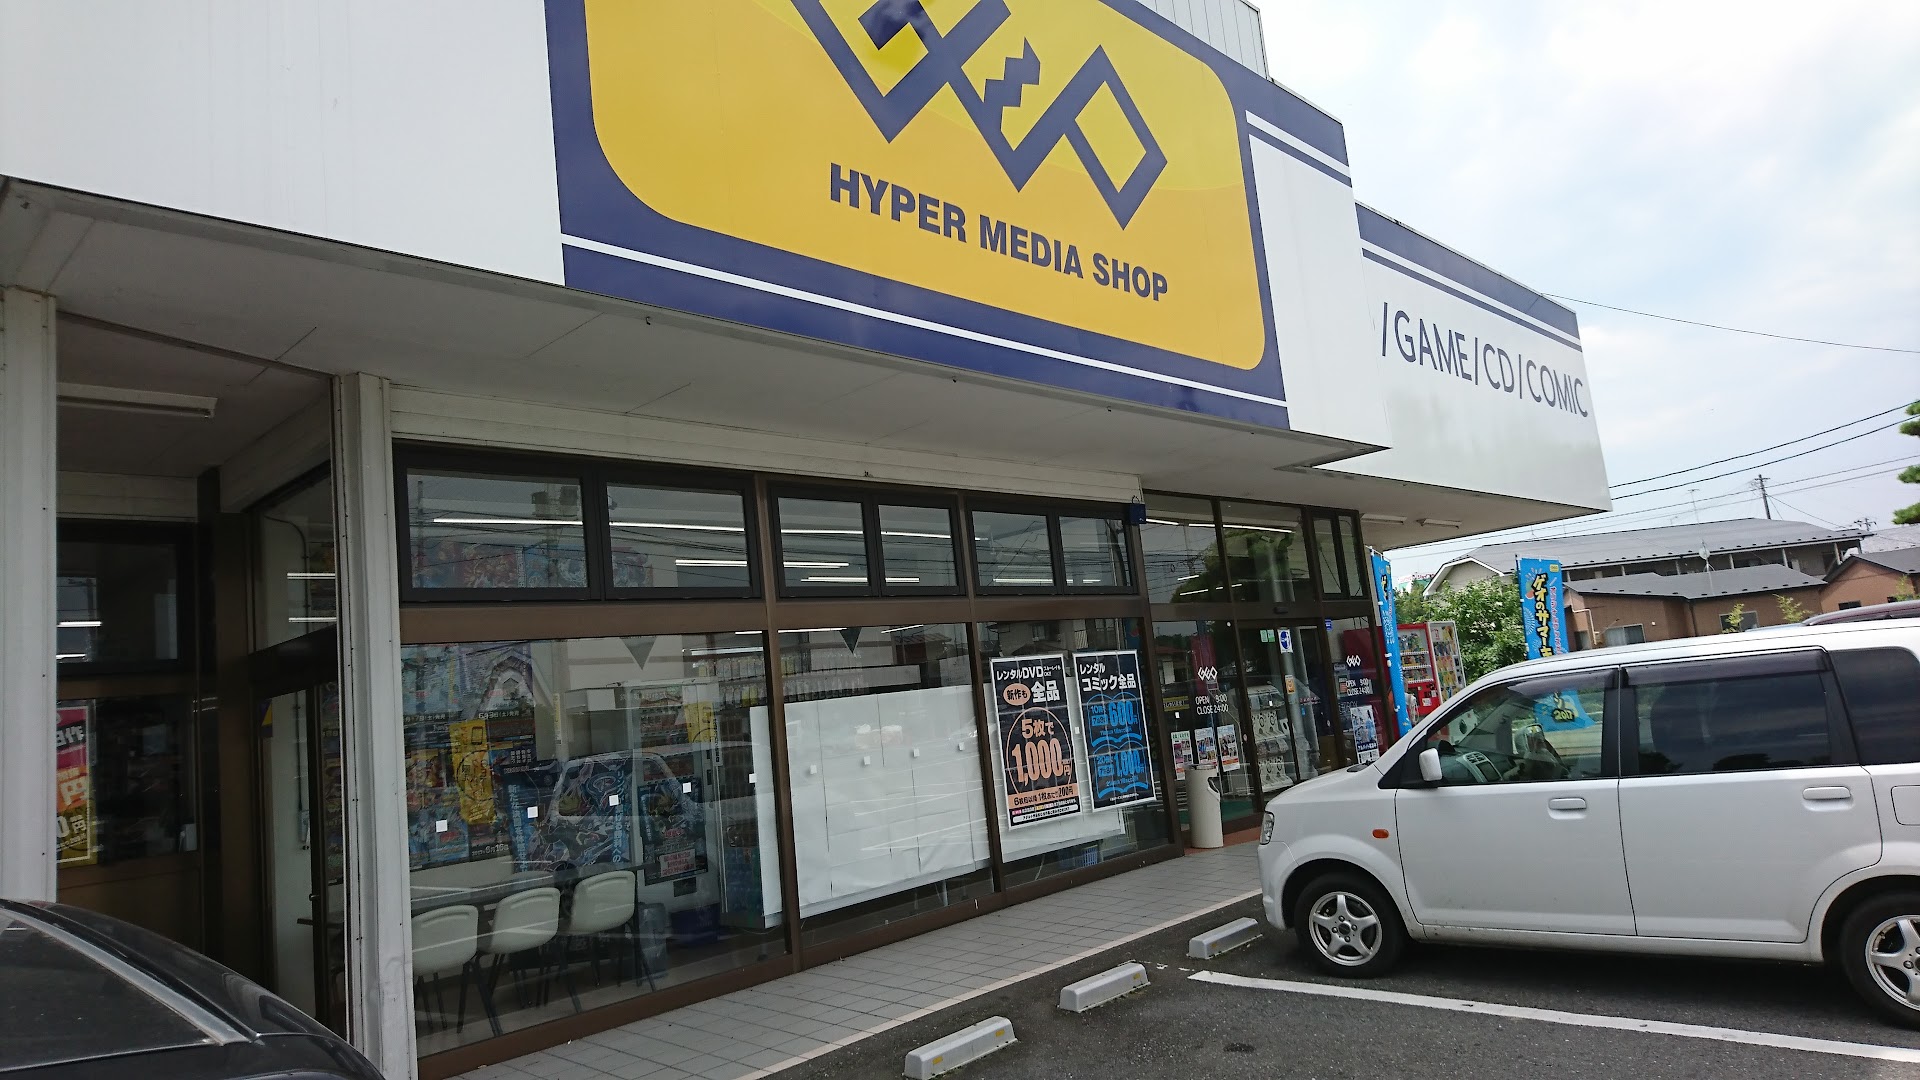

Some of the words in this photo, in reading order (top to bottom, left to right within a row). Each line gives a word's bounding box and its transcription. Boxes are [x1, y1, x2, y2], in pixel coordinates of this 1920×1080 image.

[830, 162, 967, 243] HYPER
[979, 214, 1084, 279] MEDIA
[1091, 252, 1169, 301] SHOP
[996, 666, 1044, 681] レンタルDVD
[1080, 662, 1106, 675] レンタル
[1081, 672, 1137, 692] コミック全品
[1006, 688, 1028, 701] 新作も
[1031, 680, 1061, 703] 全品
[1195, 695, 1210, 706] OPEN
[1196, 705, 1213, 716] CLOSE
[1021, 718, 1055, 739] 5枚で
[1012, 737, 1072, 786] 1,000円
